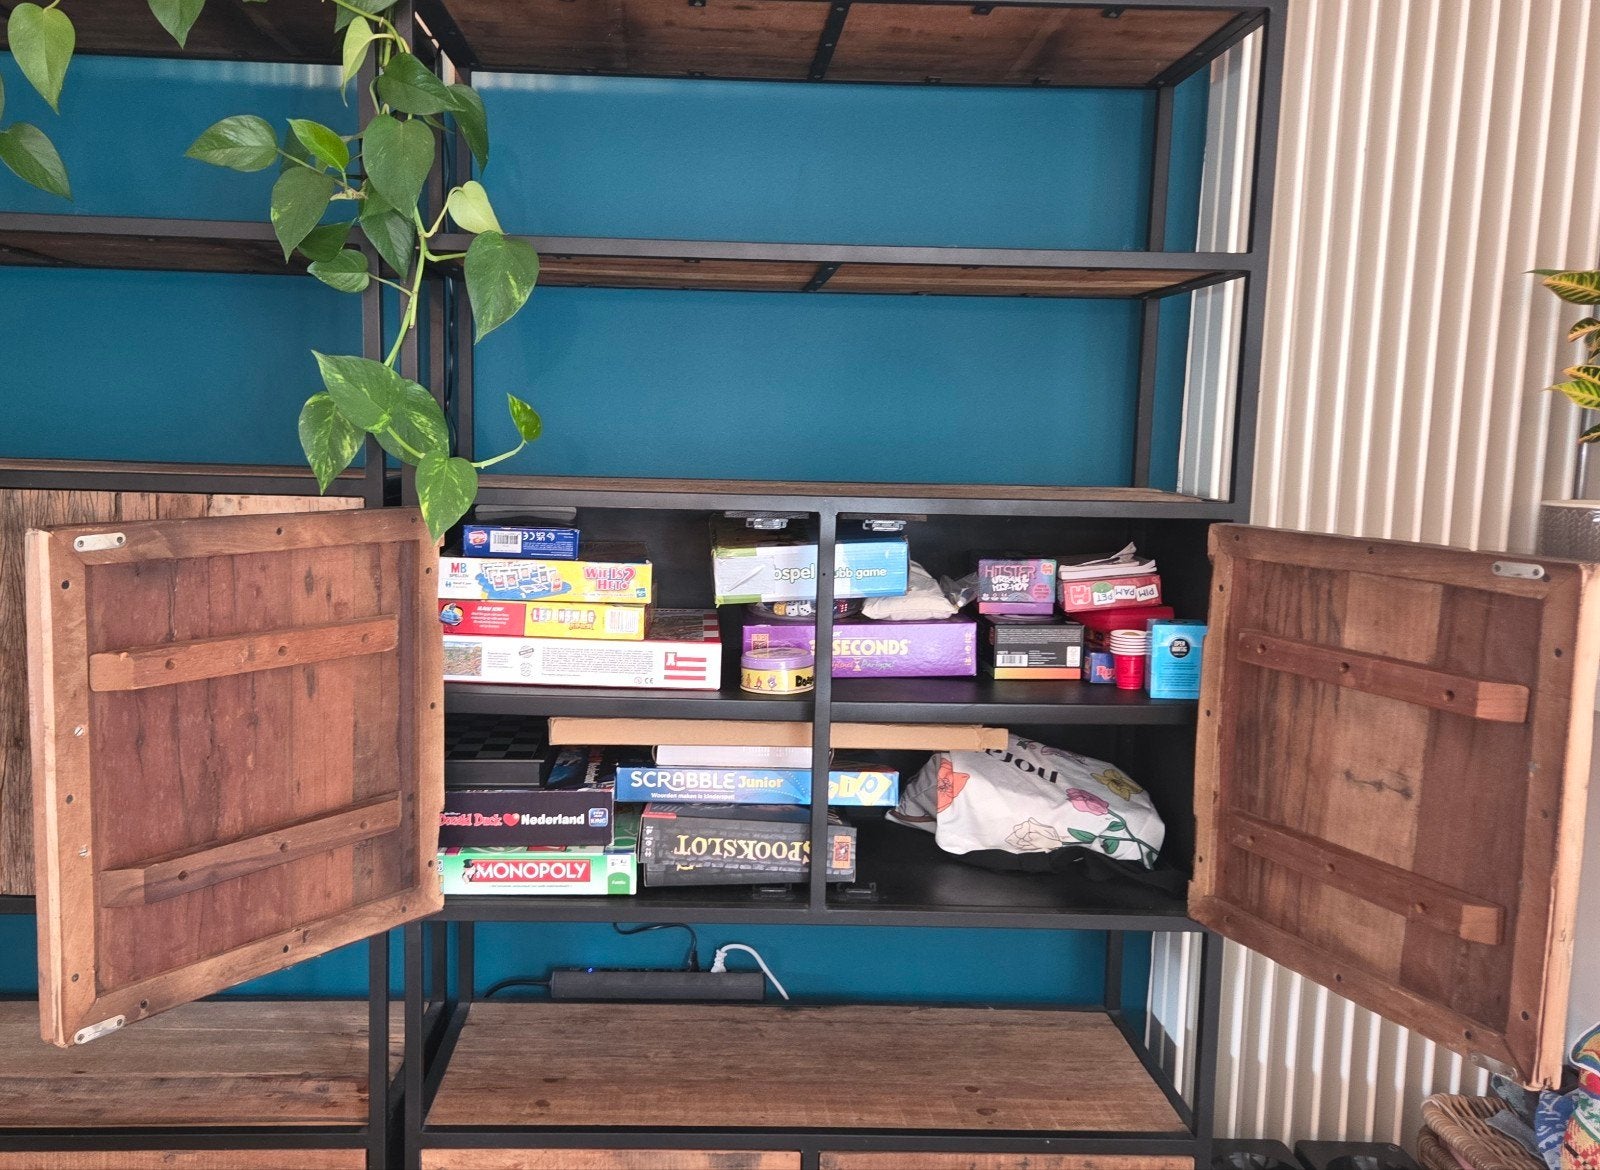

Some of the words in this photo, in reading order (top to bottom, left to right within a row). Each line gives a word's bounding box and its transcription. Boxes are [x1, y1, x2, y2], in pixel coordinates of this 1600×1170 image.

[450, 562, 467, 573] MB
[855, 567, 888, 580] game
[1096, 592, 1114, 602] PET
[1115, 588, 1135, 596] PAM
[1138, 587, 1155, 598] PIM
[832, 639, 909, 656] SECONDS
[630, 770, 737, 792] SCRABBLE
[738, 775, 784, 789] Junior
[474, 813, 503, 827] Duck
[520, 813, 585, 826] Nederland
[475, 862, 587, 879] MONOPOLY
